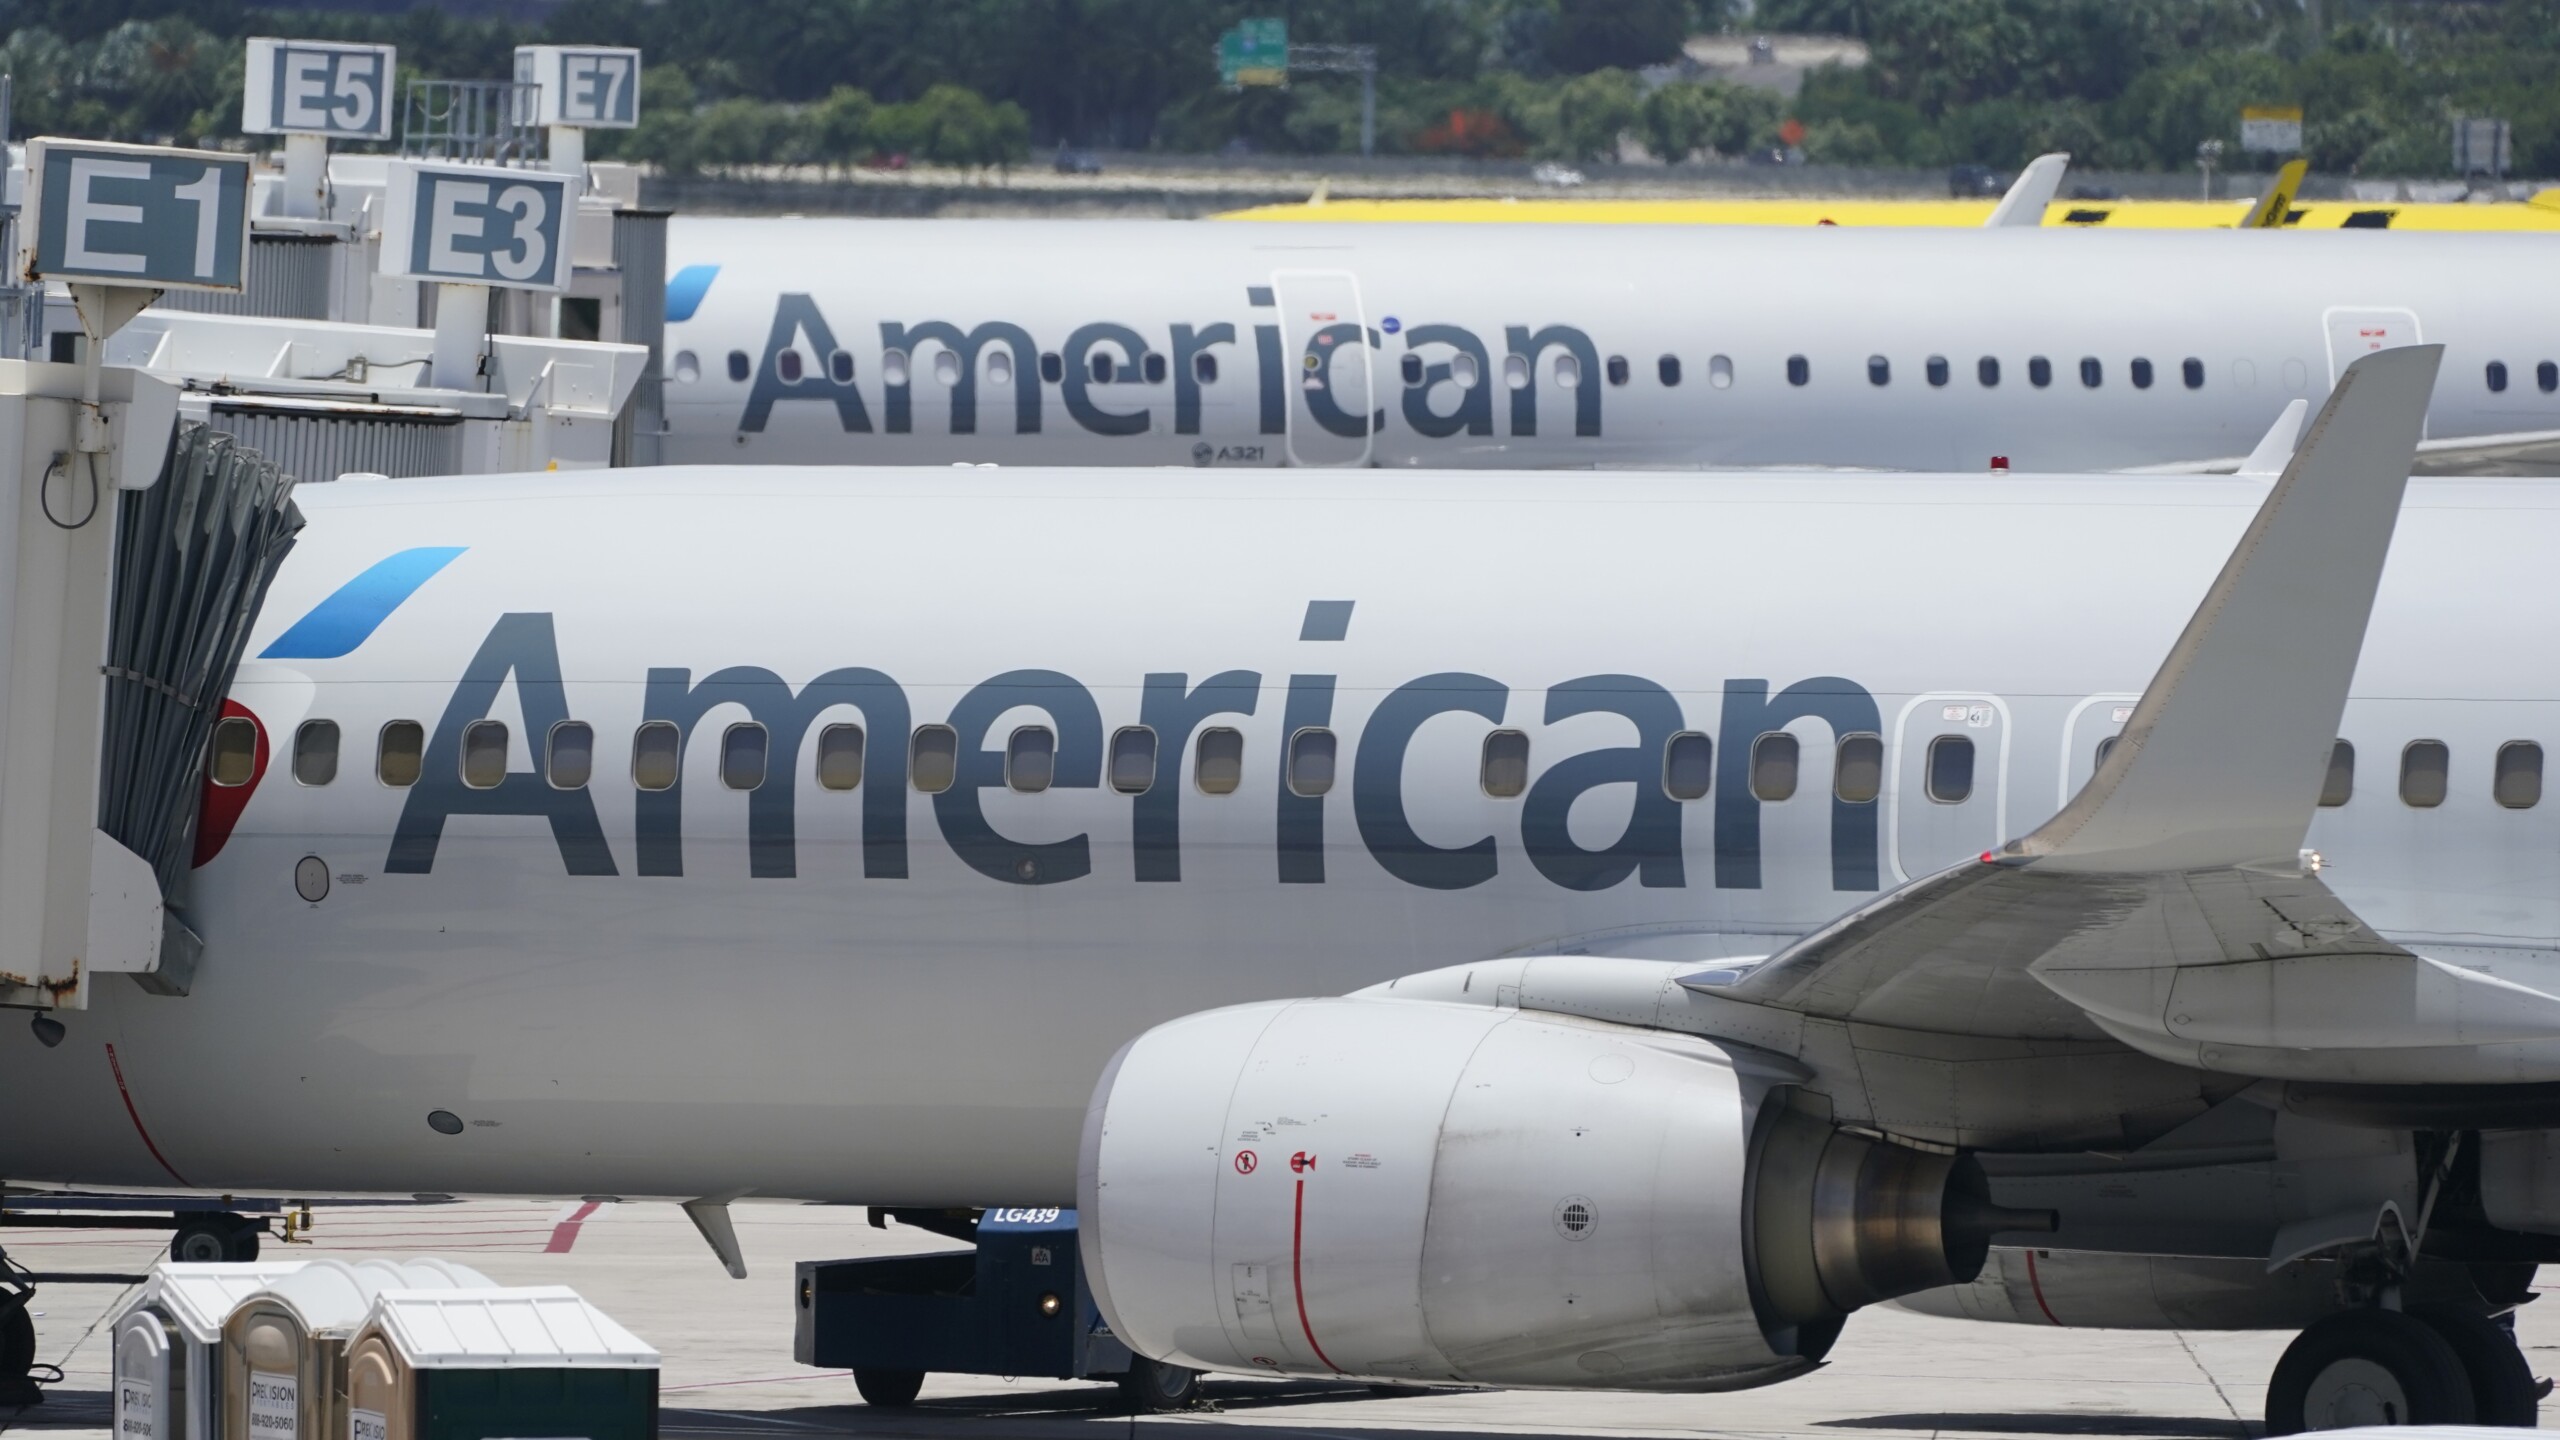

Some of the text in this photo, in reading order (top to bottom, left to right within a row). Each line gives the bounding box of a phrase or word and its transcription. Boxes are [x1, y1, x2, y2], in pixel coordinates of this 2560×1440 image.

[282, 51, 376, 131] E5
[565, 55, 628, 121] E7
[64, 157, 221, 278] E1
[427, 180, 547, 281] E3
[738, 286, 1603, 438] American
[1217, 446, 1264, 461] A321
[384, 599, 1882, 892] American
[993, 1208, 1060, 1223] LG439
[252, 1381, 295, 1405] PRECISION
